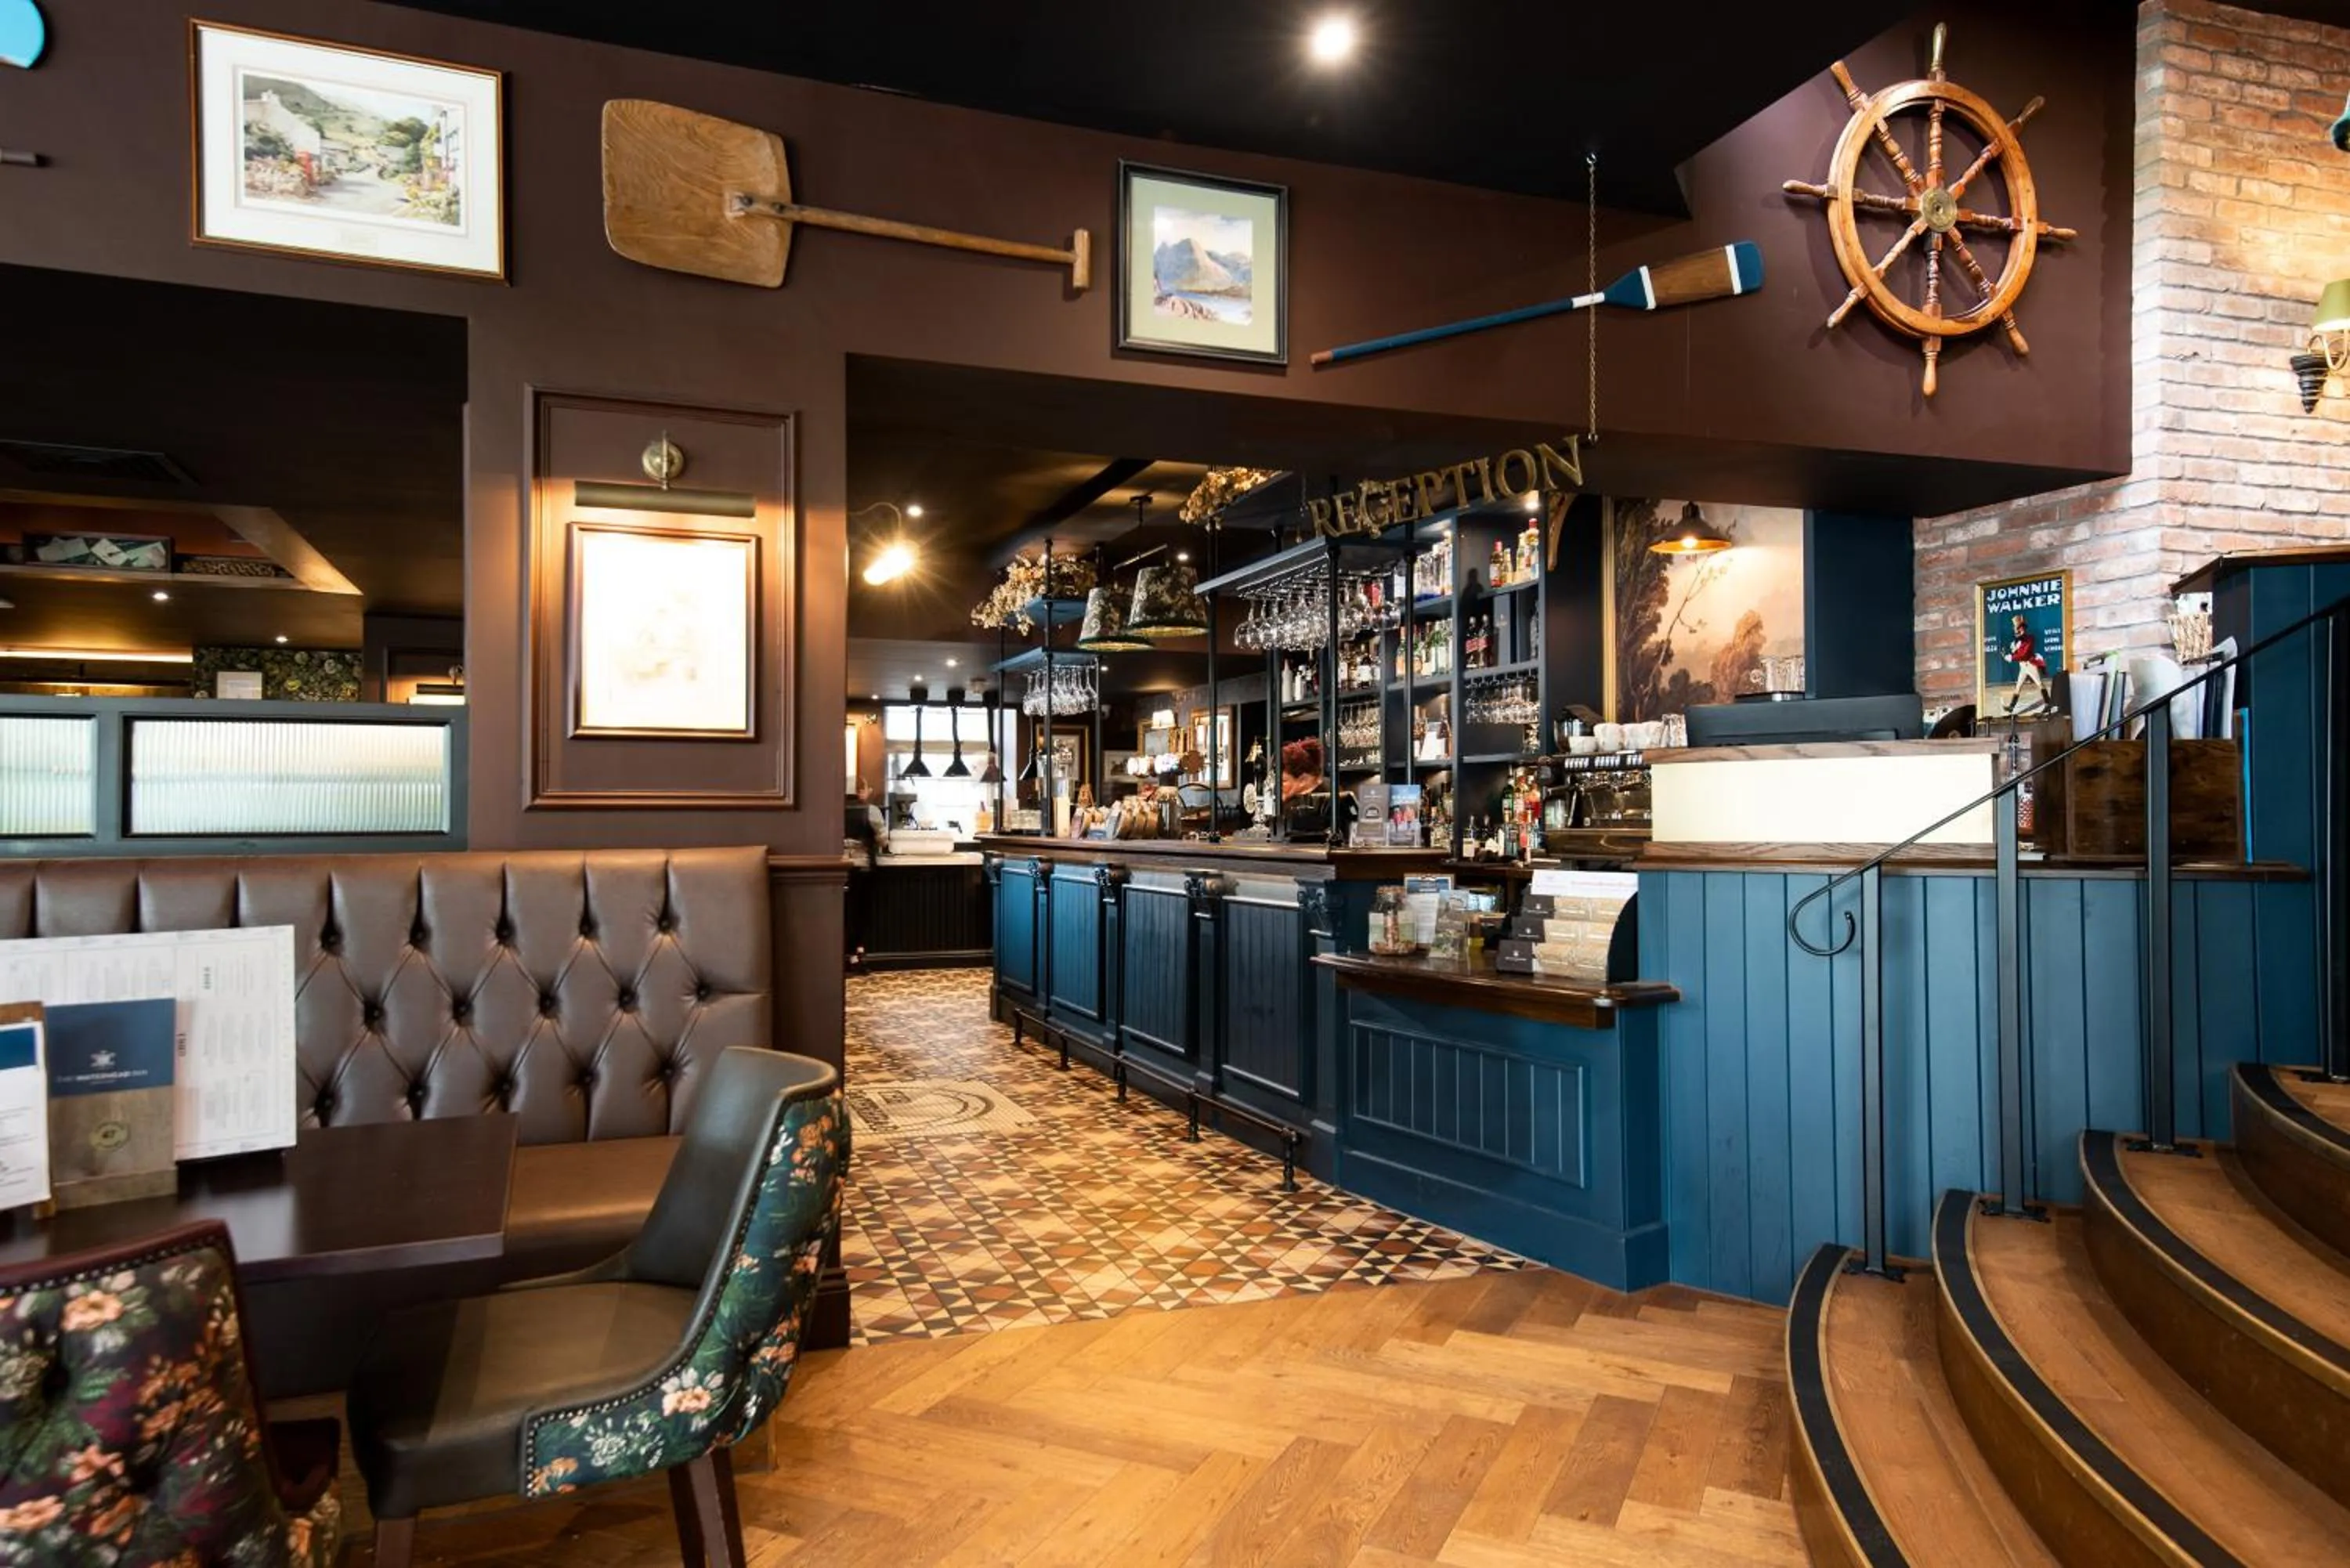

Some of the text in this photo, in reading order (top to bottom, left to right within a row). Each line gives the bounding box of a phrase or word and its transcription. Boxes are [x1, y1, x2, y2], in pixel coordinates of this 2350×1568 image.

[1307, 434, 1584, 537] RECEPTION
[1987, 579, 2063, 602] JOHNNIE
[1987, 593, 2061, 613] WALKER
